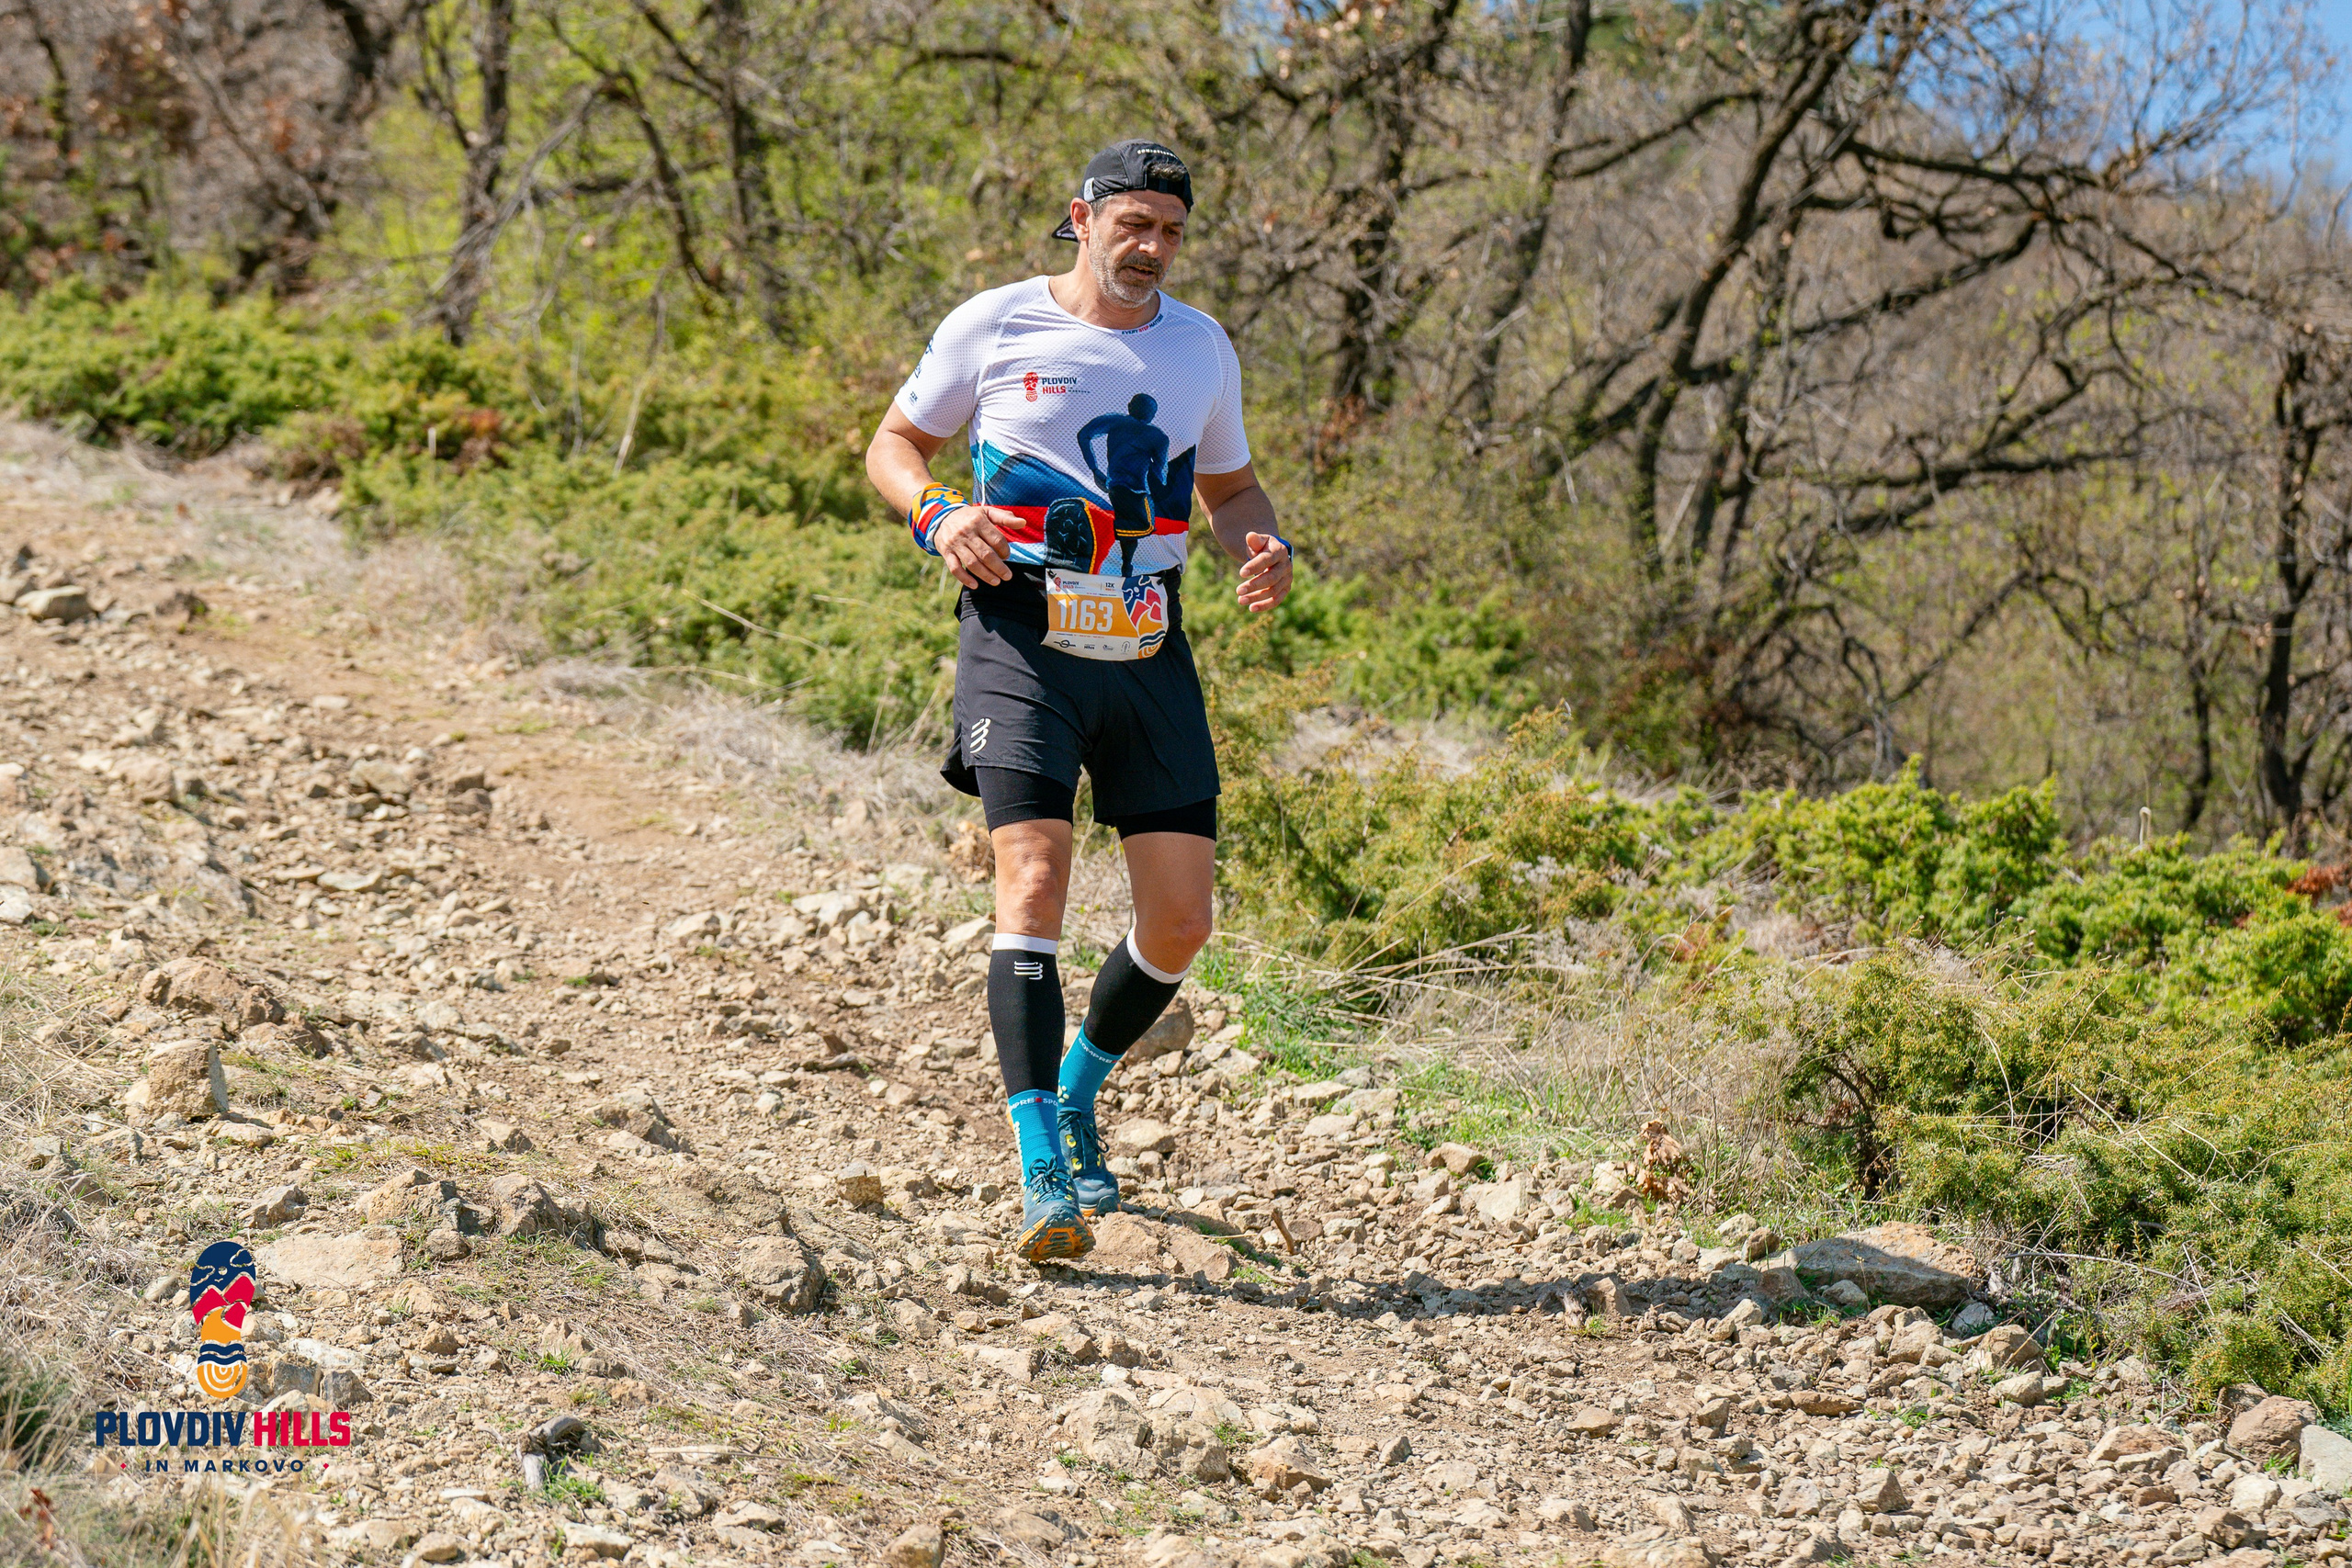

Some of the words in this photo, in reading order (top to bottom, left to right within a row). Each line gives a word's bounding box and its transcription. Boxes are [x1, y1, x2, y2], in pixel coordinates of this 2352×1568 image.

[1042, 377, 1077, 385] PLOVDIV
[1042, 386, 1066, 394] HILLS
[1057, 598, 1114, 632] 1163
